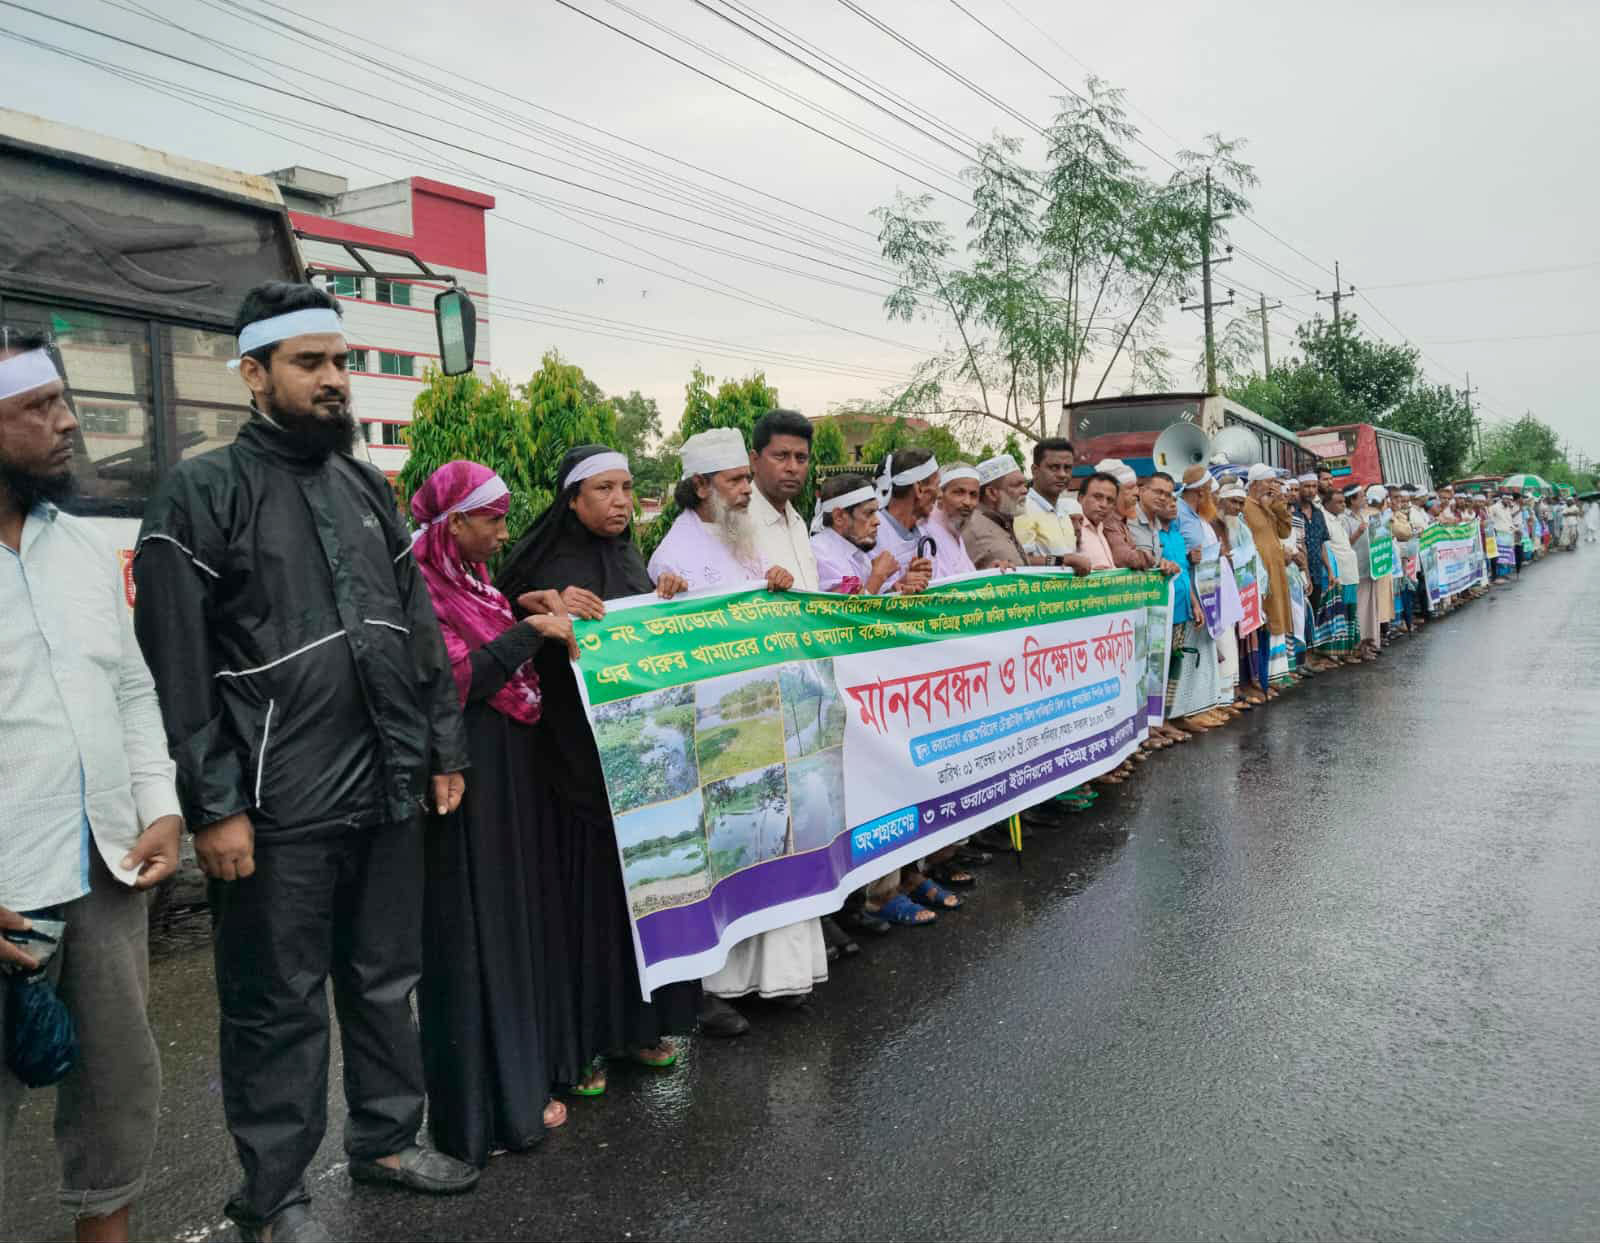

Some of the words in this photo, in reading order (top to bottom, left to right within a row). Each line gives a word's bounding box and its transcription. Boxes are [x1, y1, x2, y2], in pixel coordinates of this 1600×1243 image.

[580, 633, 601, 651] ৩
[607, 625, 643, 645] নং
[641, 608, 729, 635] ভরাডোবা
[727, 598, 801, 624] ইউনিয়নের
[597, 664, 632, 684] এর
[638, 651, 689, 675] গরুর
[691, 638, 760, 664] খামারের
[801, 632, 812, 647] ও
[845, 661, 991, 734] মানববন্ধন
[999, 656, 1016, 695] ও
[1022, 635, 1088, 693] বিক্ষোভ
[1091, 618, 1134, 675] কর্মসূচি
[923, 809, 935, 824] ৩
[939, 801, 957, 819] নং
[960, 778, 1008, 810] ভরাডোবা
[1008, 765, 1053, 789] ইউনিয়নের
